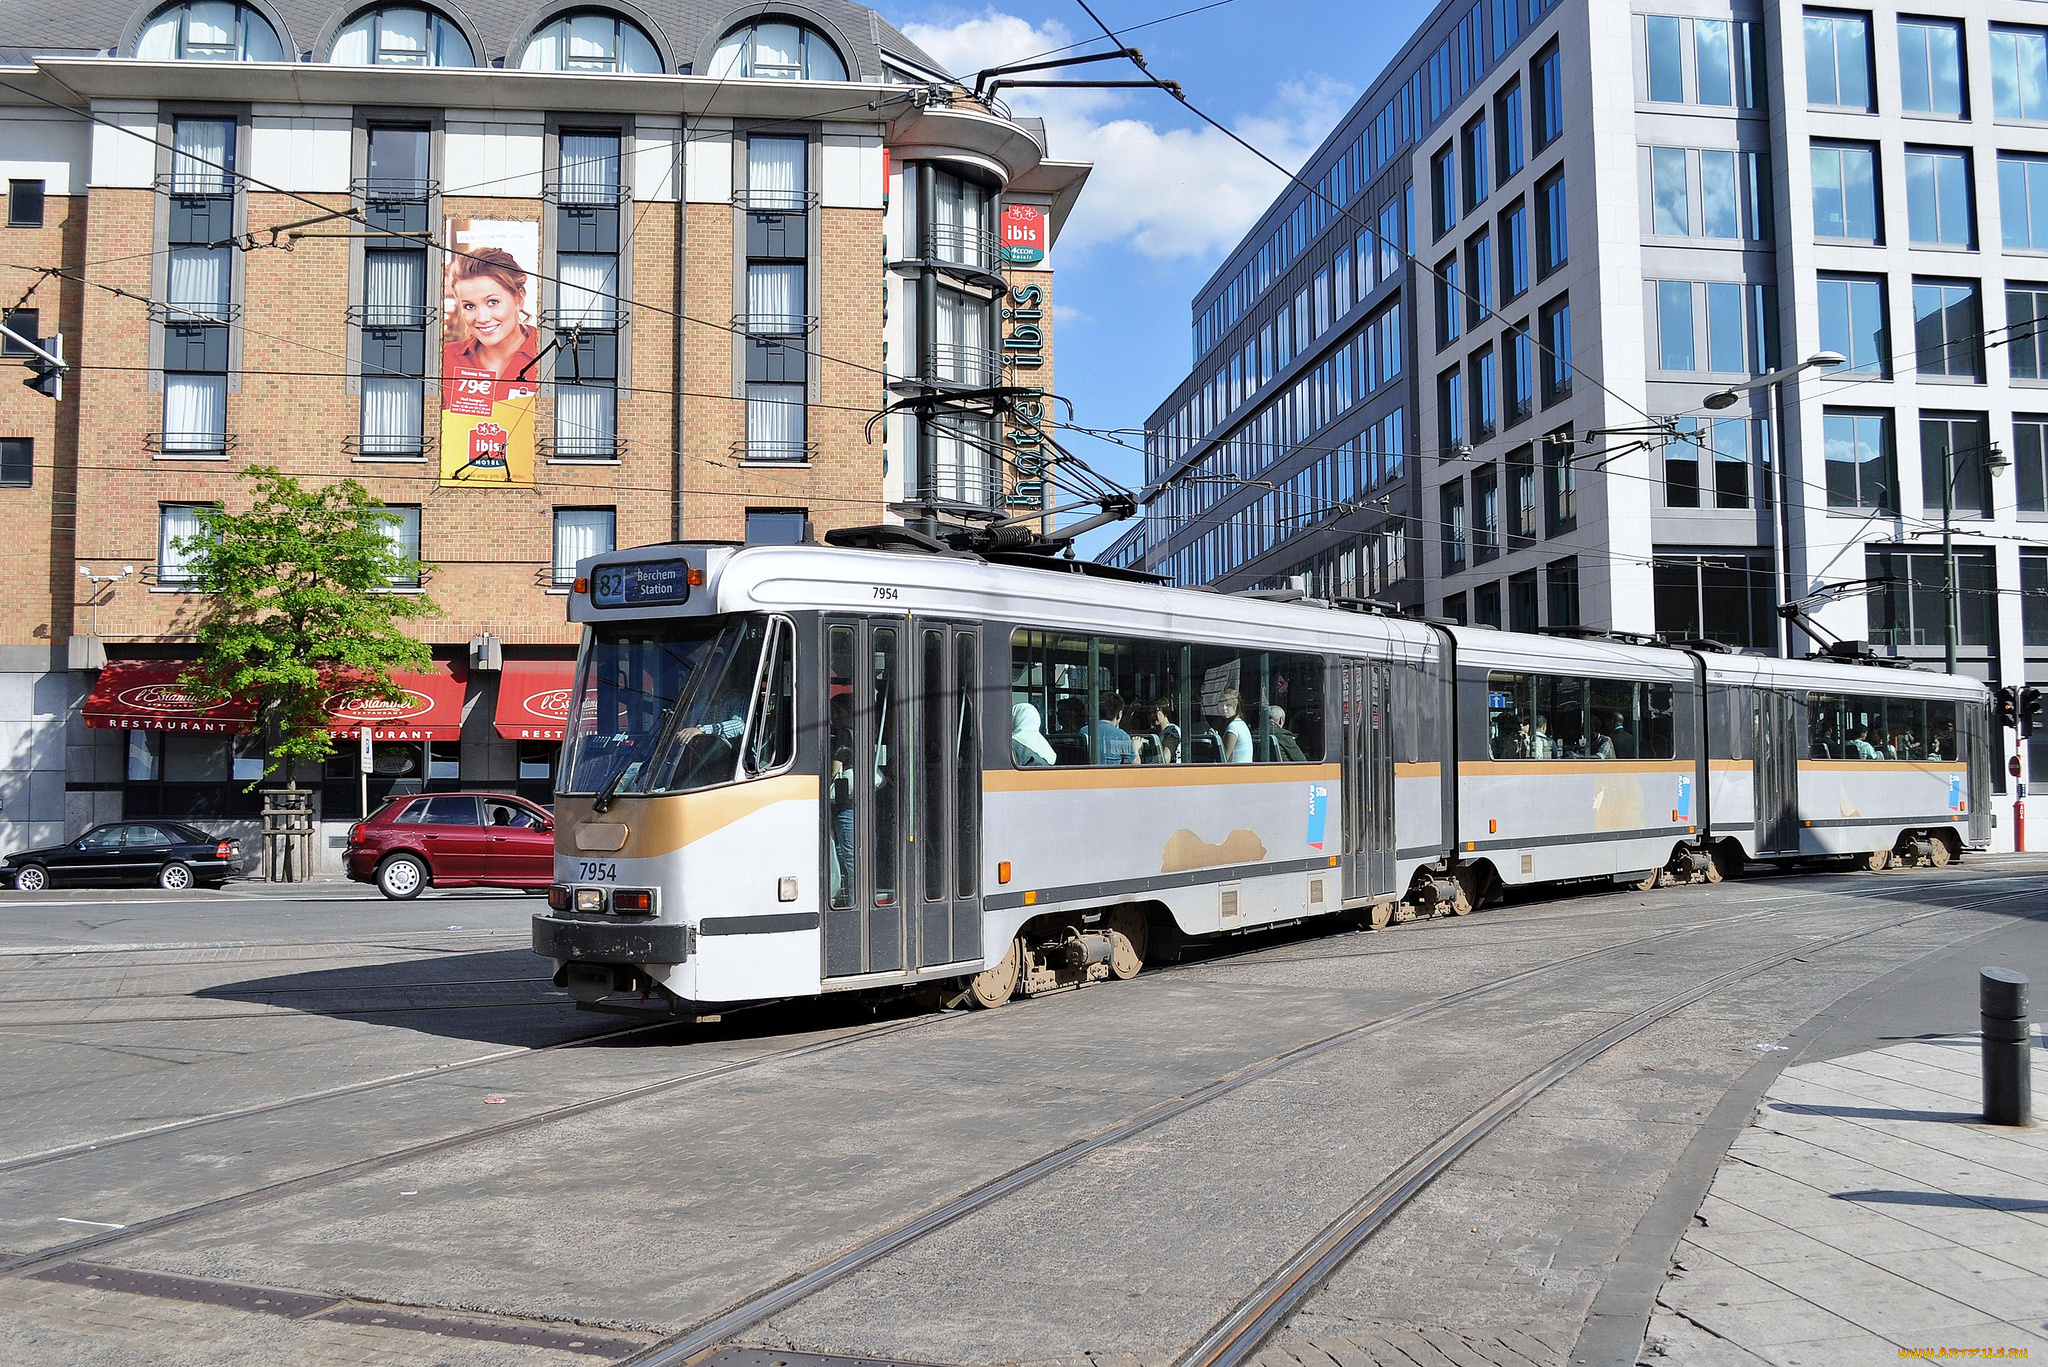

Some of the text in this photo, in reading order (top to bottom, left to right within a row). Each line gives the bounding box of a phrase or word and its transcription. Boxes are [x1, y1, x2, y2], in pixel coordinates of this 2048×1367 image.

[1007, 224, 1036, 241] ibis
[457, 379, 492, 395] 79€
[1002, 283, 1045, 505] hotel ibis
[476, 439, 500, 452] ibis
[637, 569, 676, 581] Berchem
[599, 573, 622, 597] 82
[640, 584, 673, 595] Station
[872, 586, 899, 600] 7954
[109, 719, 227, 732] RESTAURANT
[330, 731, 434, 739] ESTURANT
[579, 862, 617, 882] 7954
